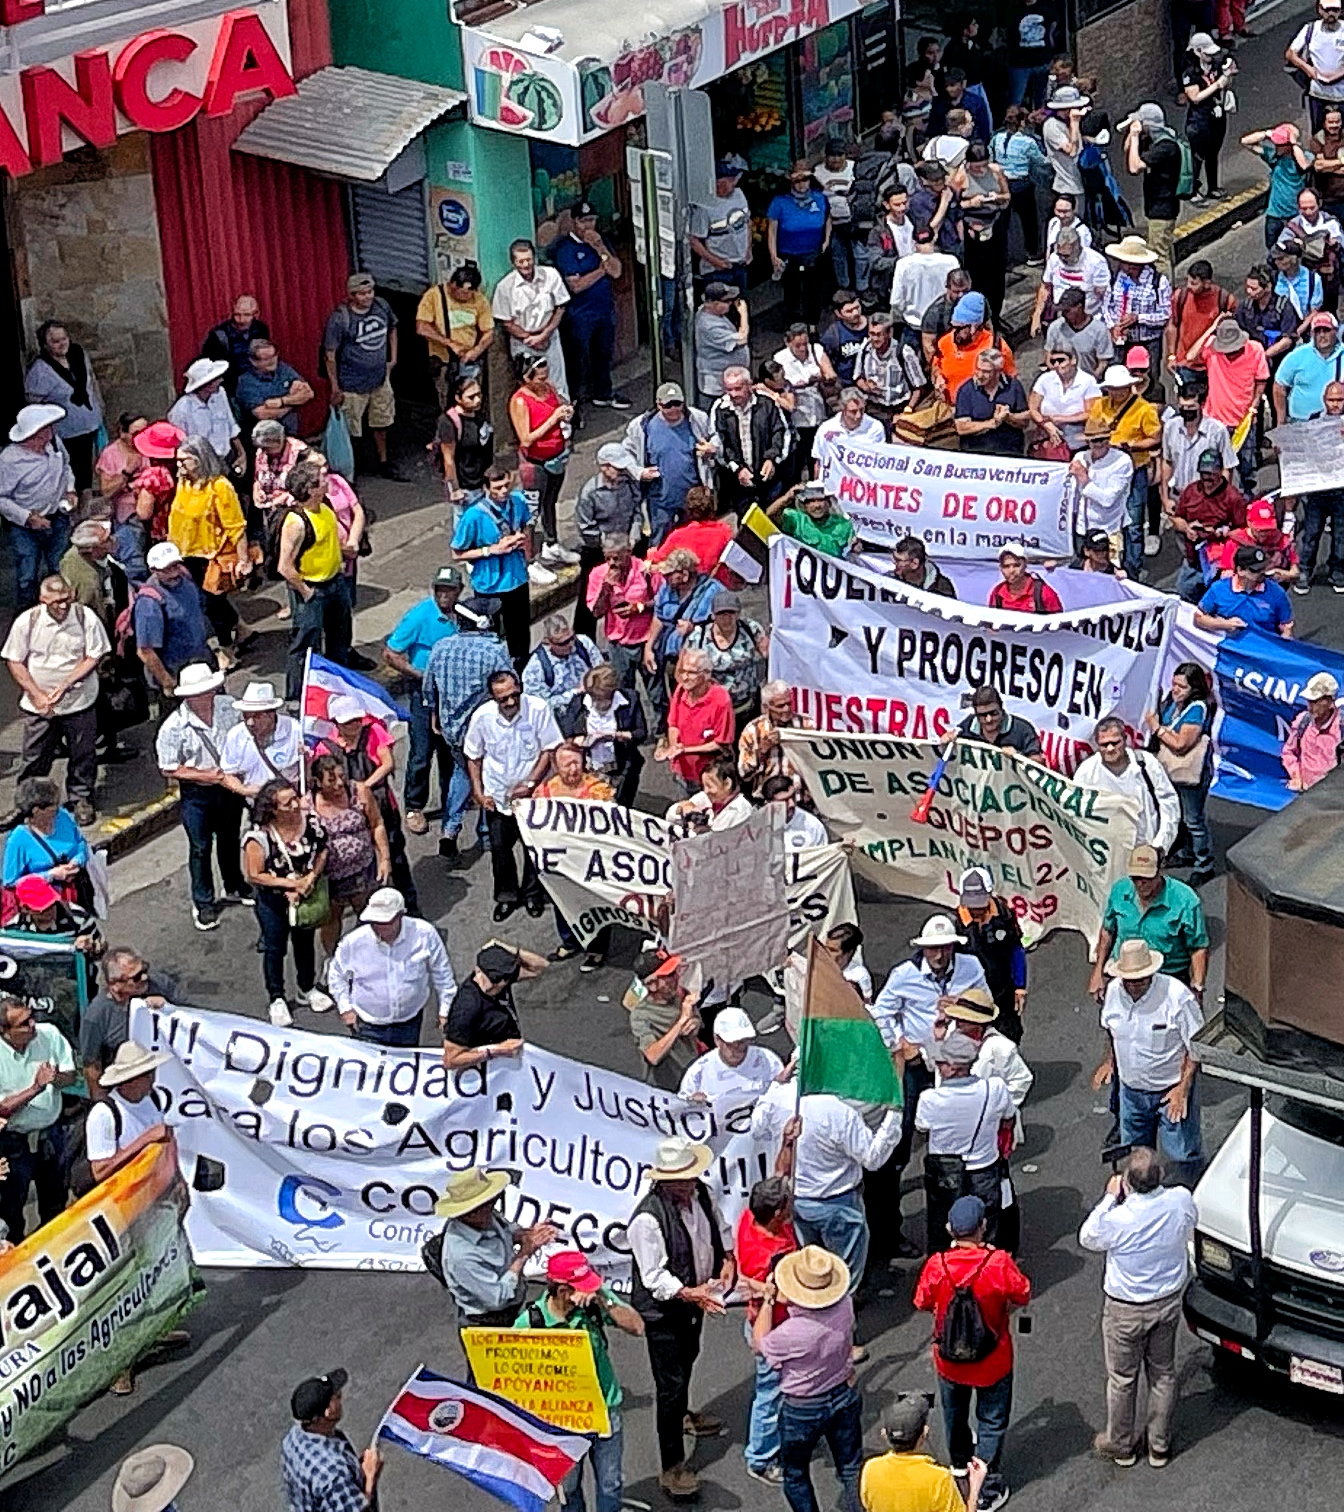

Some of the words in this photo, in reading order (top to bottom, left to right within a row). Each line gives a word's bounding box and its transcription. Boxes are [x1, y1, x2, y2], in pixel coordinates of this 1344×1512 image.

[836, 444, 910, 474] Seccional
[913, 457, 942, 478] San
[942, 492, 978, 521] DE
[986, 496, 1036, 526] ORO
[923, 527, 946, 545] en
[950, 527, 967, 546] la
[861, 625, 887, 675] Y
[898, 629, 1064, 709] PROGRESO
[1069, 659, 1105, 720] EN
[818, 768, 875, 798] DE
[526, 798, 633, 838] UNION
[926, 806, 1054, 856] QUEPOS
[584, 849, 672, 889] ASOC
[572, 905, 643, 941] IGIMOS
[225, 1030, 489, 1099] Dignidad
[531, 1063, 556, 1112] y
[573, 1070, 755, 1142] Justicia
[287, 1108, 374, 1156] los
[395, 1116, 656, 1198] Agricultor
[368, 1219, 436, 1246] Confe
[6, 1213, 122, 1331] ajal
[13, 1372, 42, 1416] NO
[46, 1367, 58, 1389] a
[60, 1338, 86, 1376] los
[89, 1239, 180, 1350] Agricultores
[0, 1340, 42, 1380] URA
[540, 1399, 594, 1413] ALIANZA
